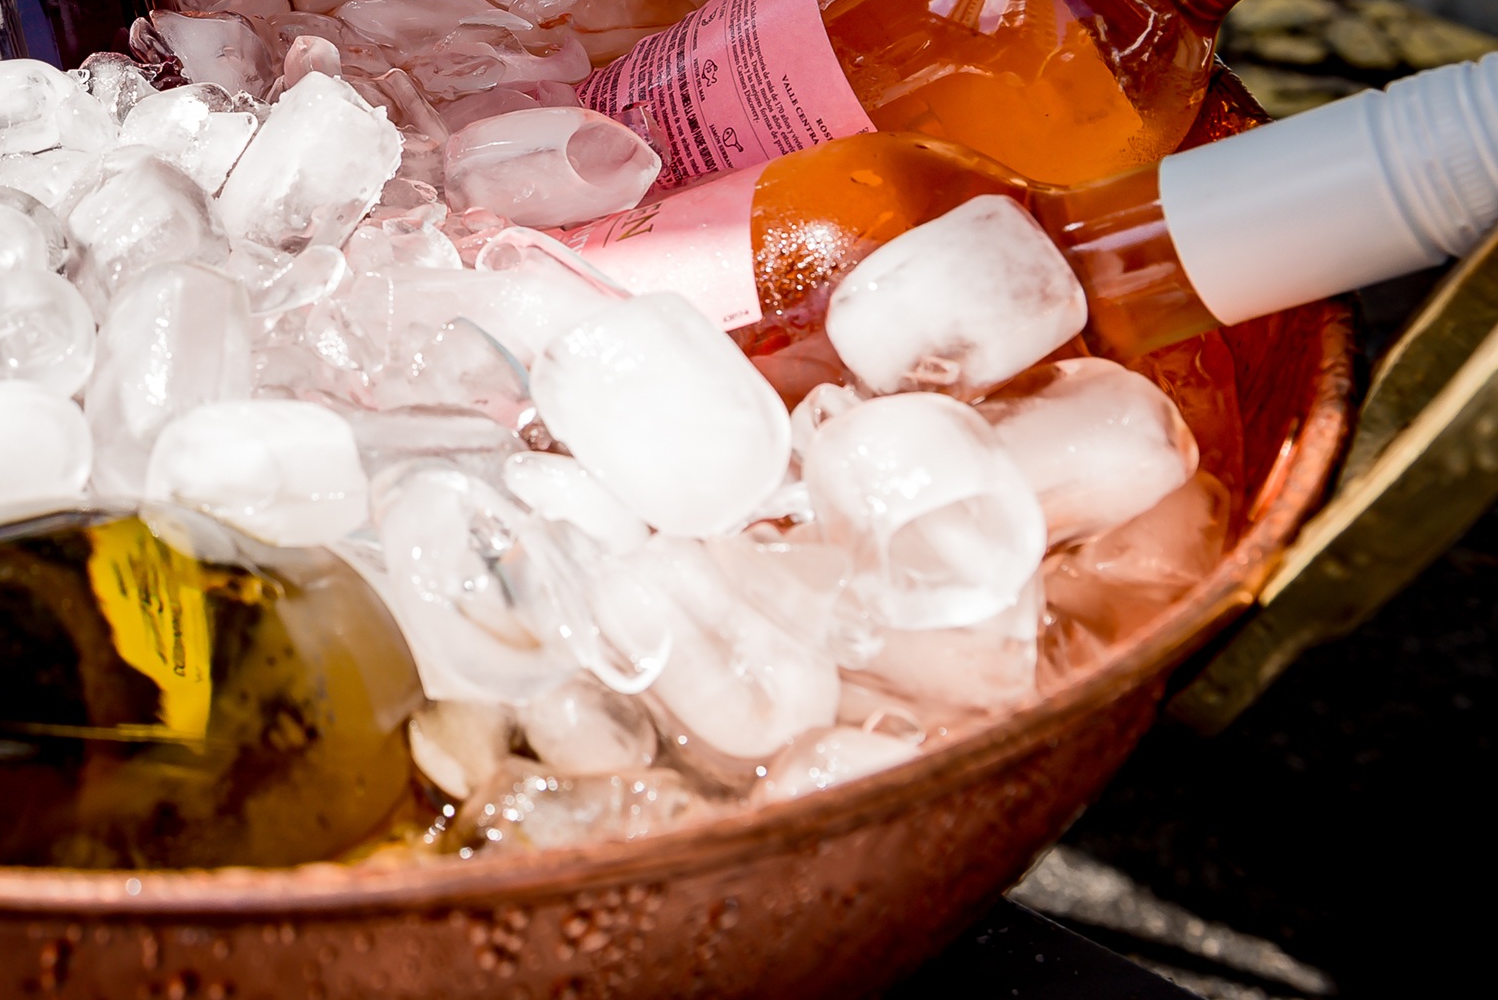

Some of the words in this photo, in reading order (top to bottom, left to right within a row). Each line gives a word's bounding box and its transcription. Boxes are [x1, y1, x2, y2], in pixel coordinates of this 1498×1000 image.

[735, 64, 749, 90] Carmen
[742, 89, 761, 123] Discovery.
[741, 55, 750, 69] uvas
[747, 82, 764, 109] mejores
[758, 106, 776, 130] formas
[750, 59, 764, 86] Durante
[759, 86, 776, 113] muchos
[770, 113, 784, 130] años
[773, 100, 786, 114] 170
[781, 73, 799, 106] VALLE
[779, 112, 793, 129] años
